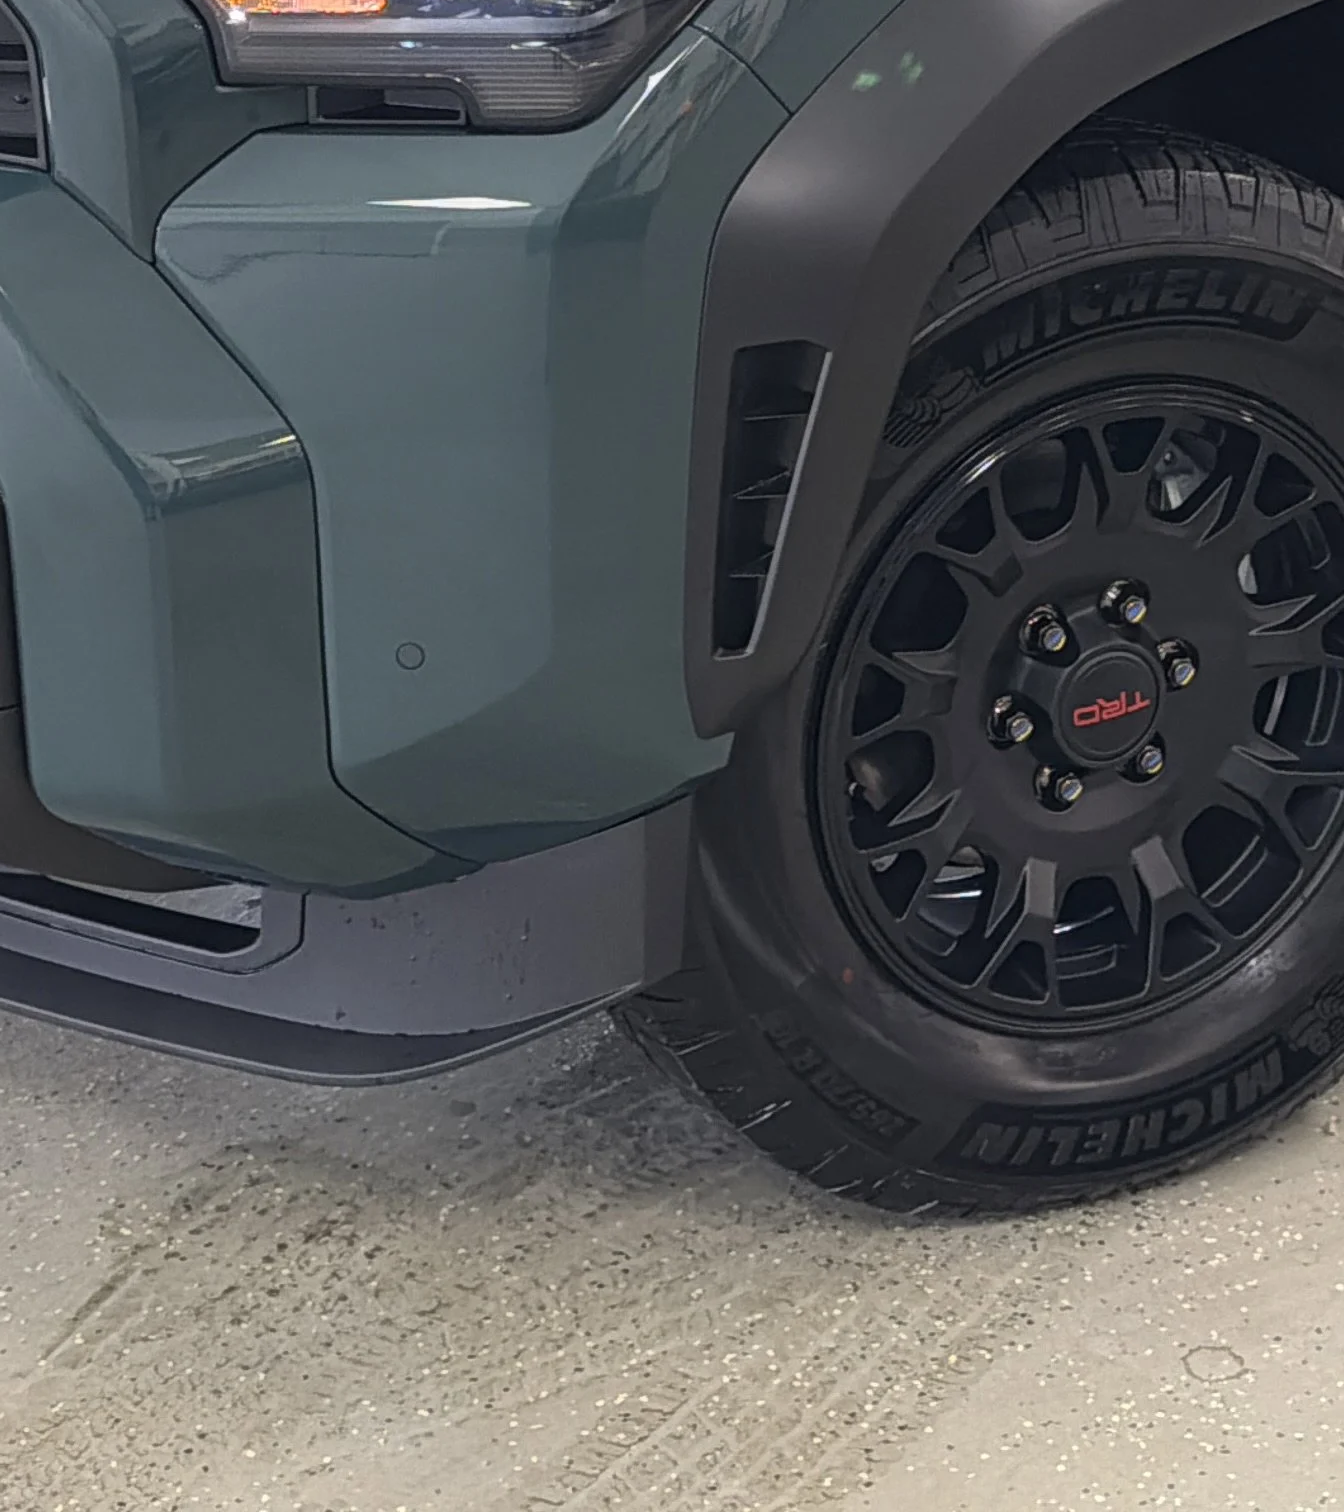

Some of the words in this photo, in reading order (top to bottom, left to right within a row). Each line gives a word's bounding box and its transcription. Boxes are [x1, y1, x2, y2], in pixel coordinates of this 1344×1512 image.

[982, 267, 1308, 369] MICHELIN
[1073, 691, 1151, 727] TRD
[960, 1047, 1285, 1167] MICHELIN
